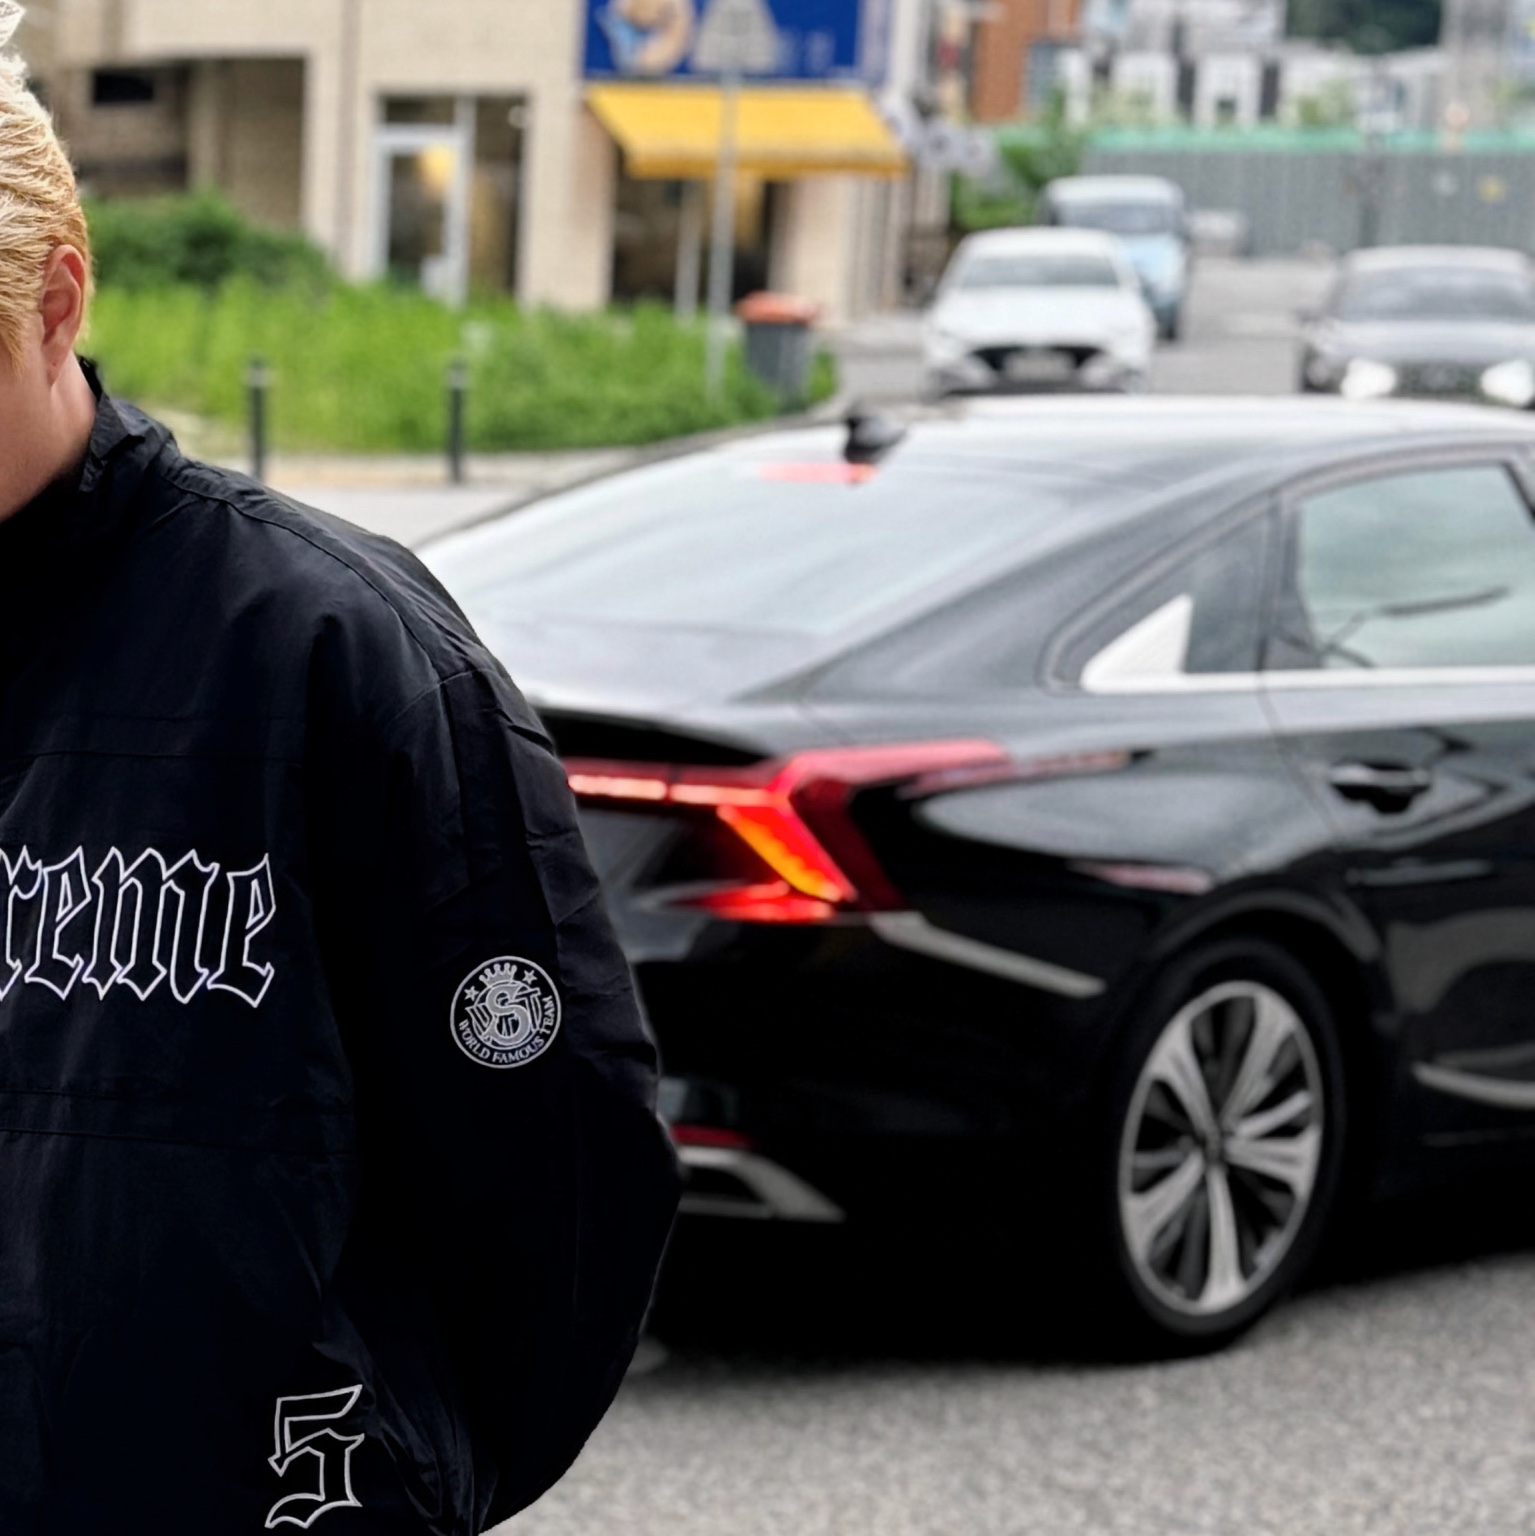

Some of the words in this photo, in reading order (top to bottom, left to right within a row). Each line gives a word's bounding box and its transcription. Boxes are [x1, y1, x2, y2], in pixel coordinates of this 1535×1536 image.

[459, 1019, 490, 1059] WORLD
[492, 1036, 544, 1063] FAMOUS
[541, 995, 556, 1034] TEAM
